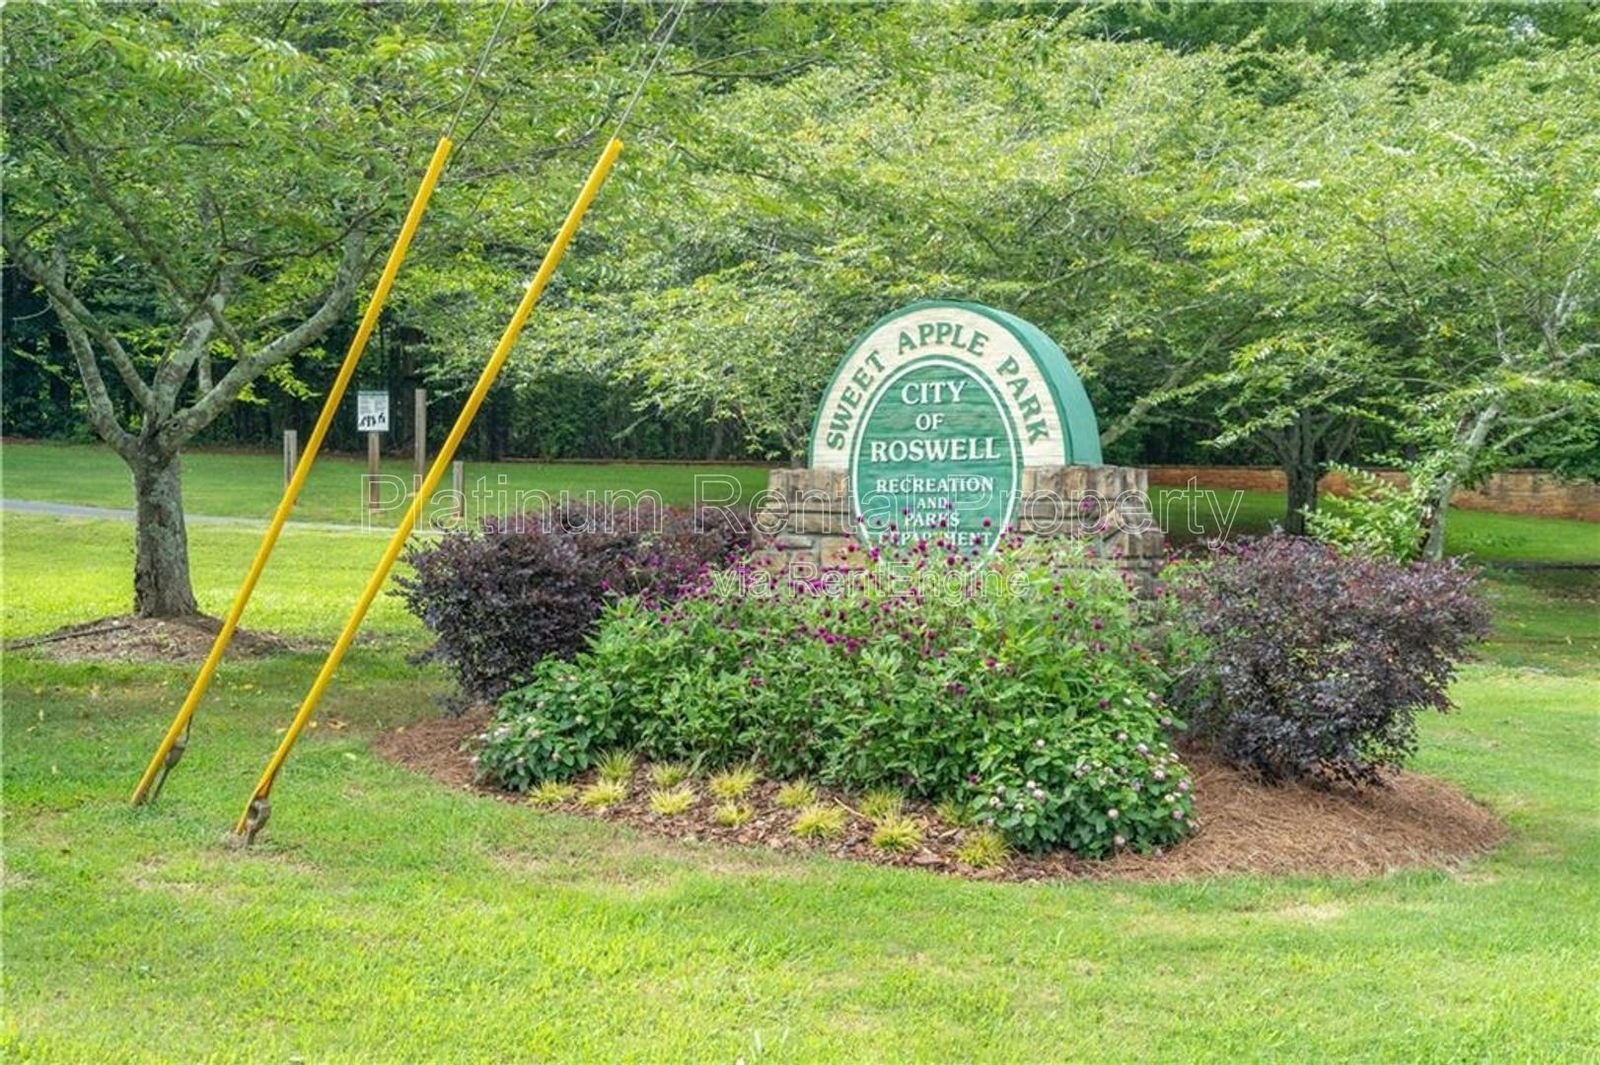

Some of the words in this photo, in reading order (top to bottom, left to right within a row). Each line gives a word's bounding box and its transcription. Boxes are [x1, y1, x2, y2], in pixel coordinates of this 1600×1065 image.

[826, 349, 888, 450] SWEET
[897, 322, 989, 357] APPLE
[996, 356, 1049, 444] PARK
[901, 381, 967, 405] CITY
[916, 413, 944, 431] OF
[871, 437, 1000, 463] ROSWELL
[876, 478, 993, 493] RECREATION
[917, 497, 948, 509] AND
